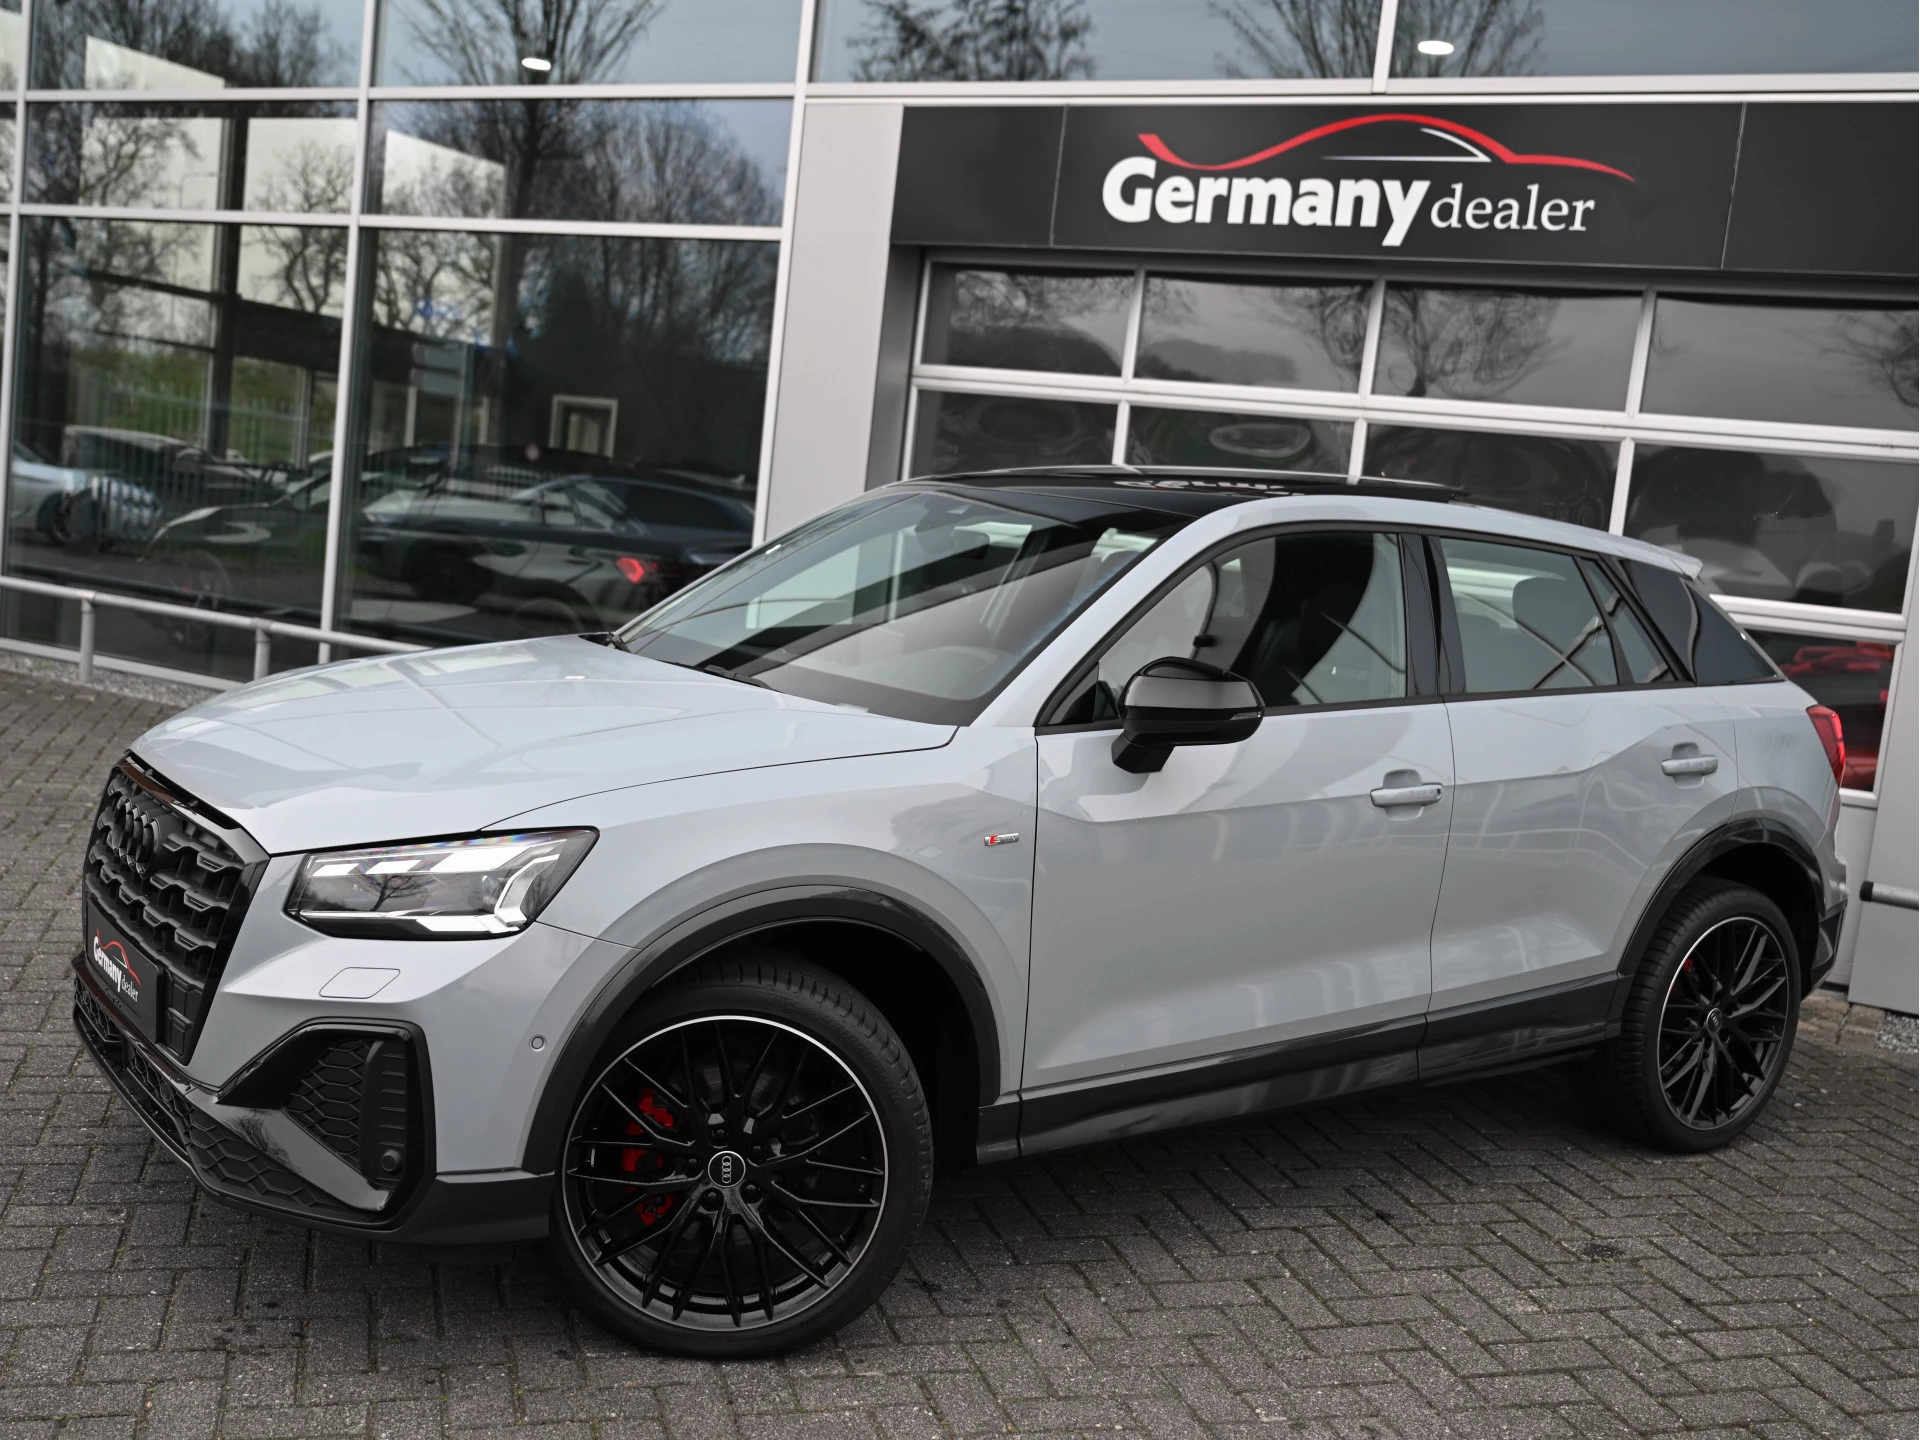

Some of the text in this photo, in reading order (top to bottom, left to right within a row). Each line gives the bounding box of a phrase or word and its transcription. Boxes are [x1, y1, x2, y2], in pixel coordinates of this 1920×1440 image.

[1102, 156, 1596, 247] Germany dealer
[93, 935, 122, 993] Germany
[121, 974, 139, 1002] dealer
